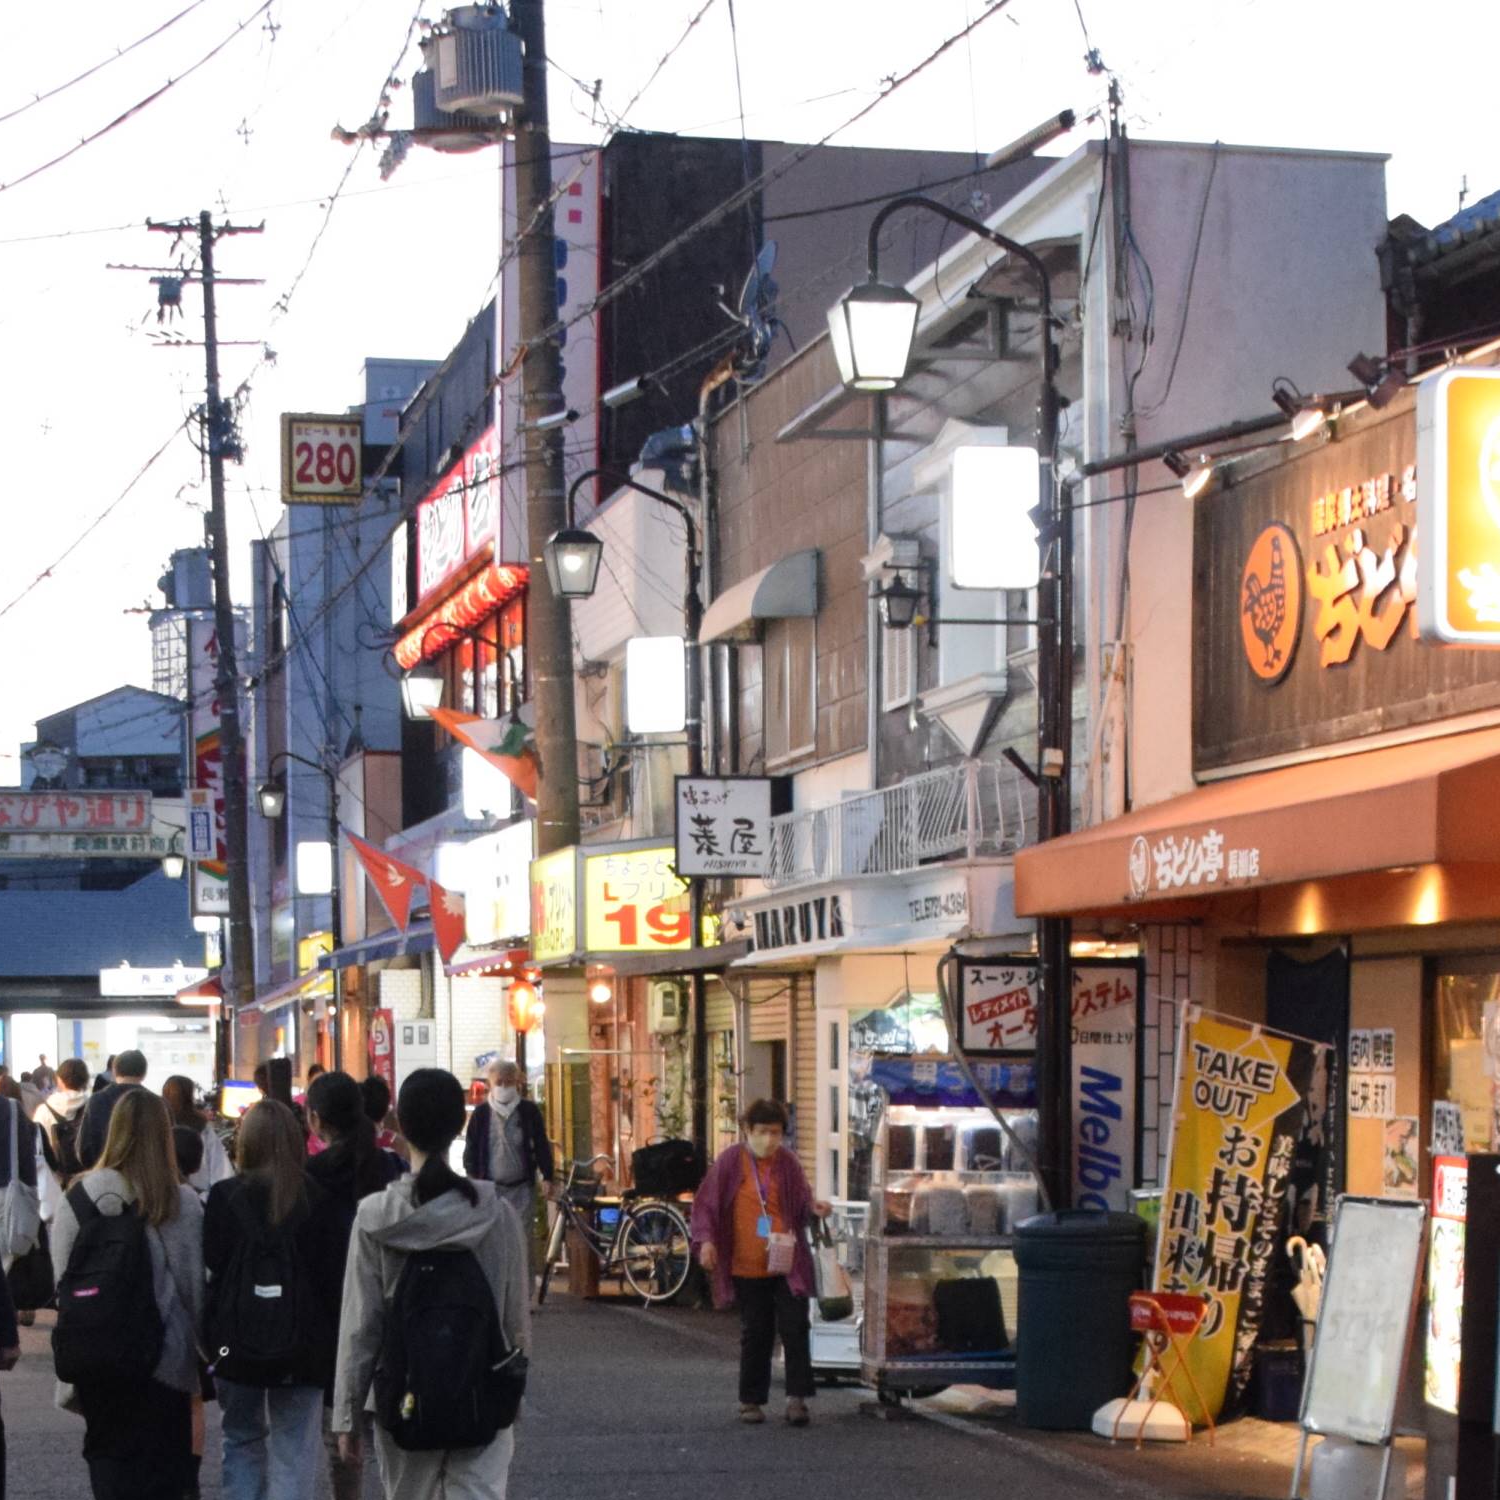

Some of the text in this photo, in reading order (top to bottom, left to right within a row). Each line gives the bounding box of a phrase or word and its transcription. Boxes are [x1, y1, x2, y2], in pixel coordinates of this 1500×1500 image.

[295, 441, 357, 486] 280
[604, 854, 676, 878] ちょっと
[754, 895, 845, 950] MARUYA
[1192, 1042, 1279, 1091] TAKE
[1193, 1078, 1258, 1119] OUT
